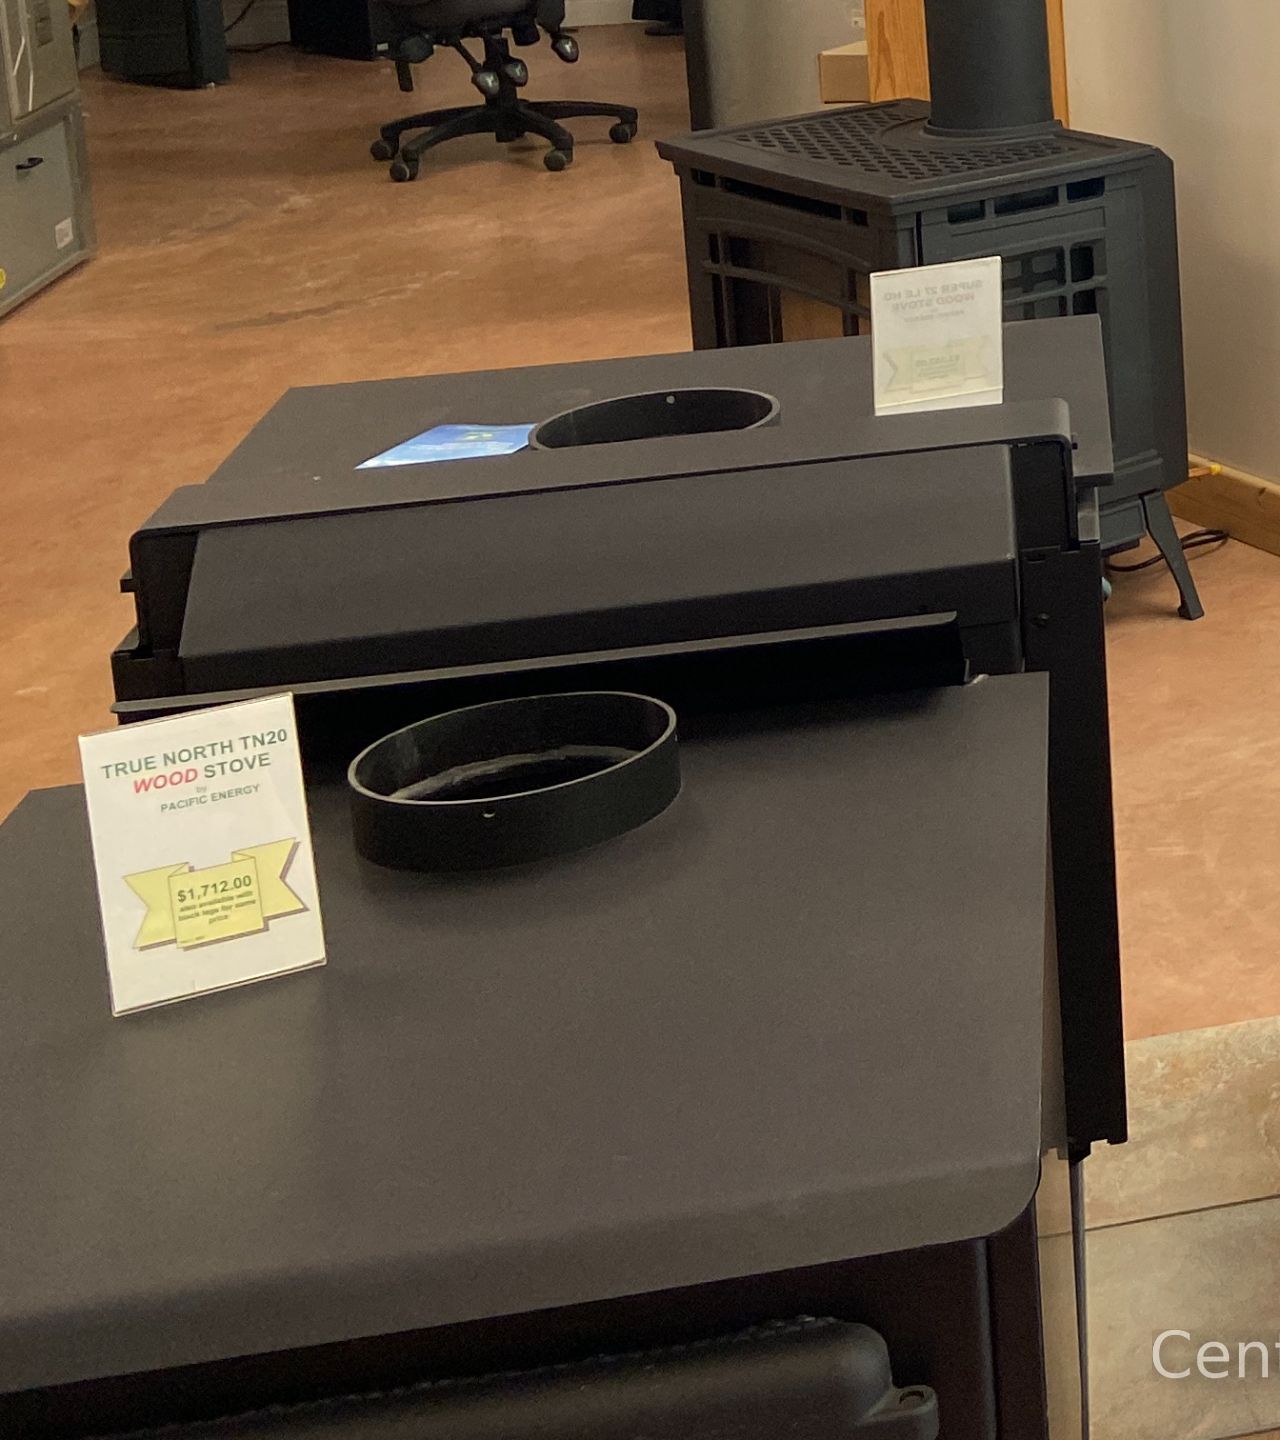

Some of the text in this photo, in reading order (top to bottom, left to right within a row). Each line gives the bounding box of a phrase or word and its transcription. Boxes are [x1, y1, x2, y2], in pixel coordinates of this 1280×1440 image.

[101, 728, 288, 779] TRUE NORTH TN20
[133, 752, 272, 794] WOOD STOVE
[160, 783, 261, 813] PACIFIC ENERGY
[177, 875, 252, 903] $1,712.00
